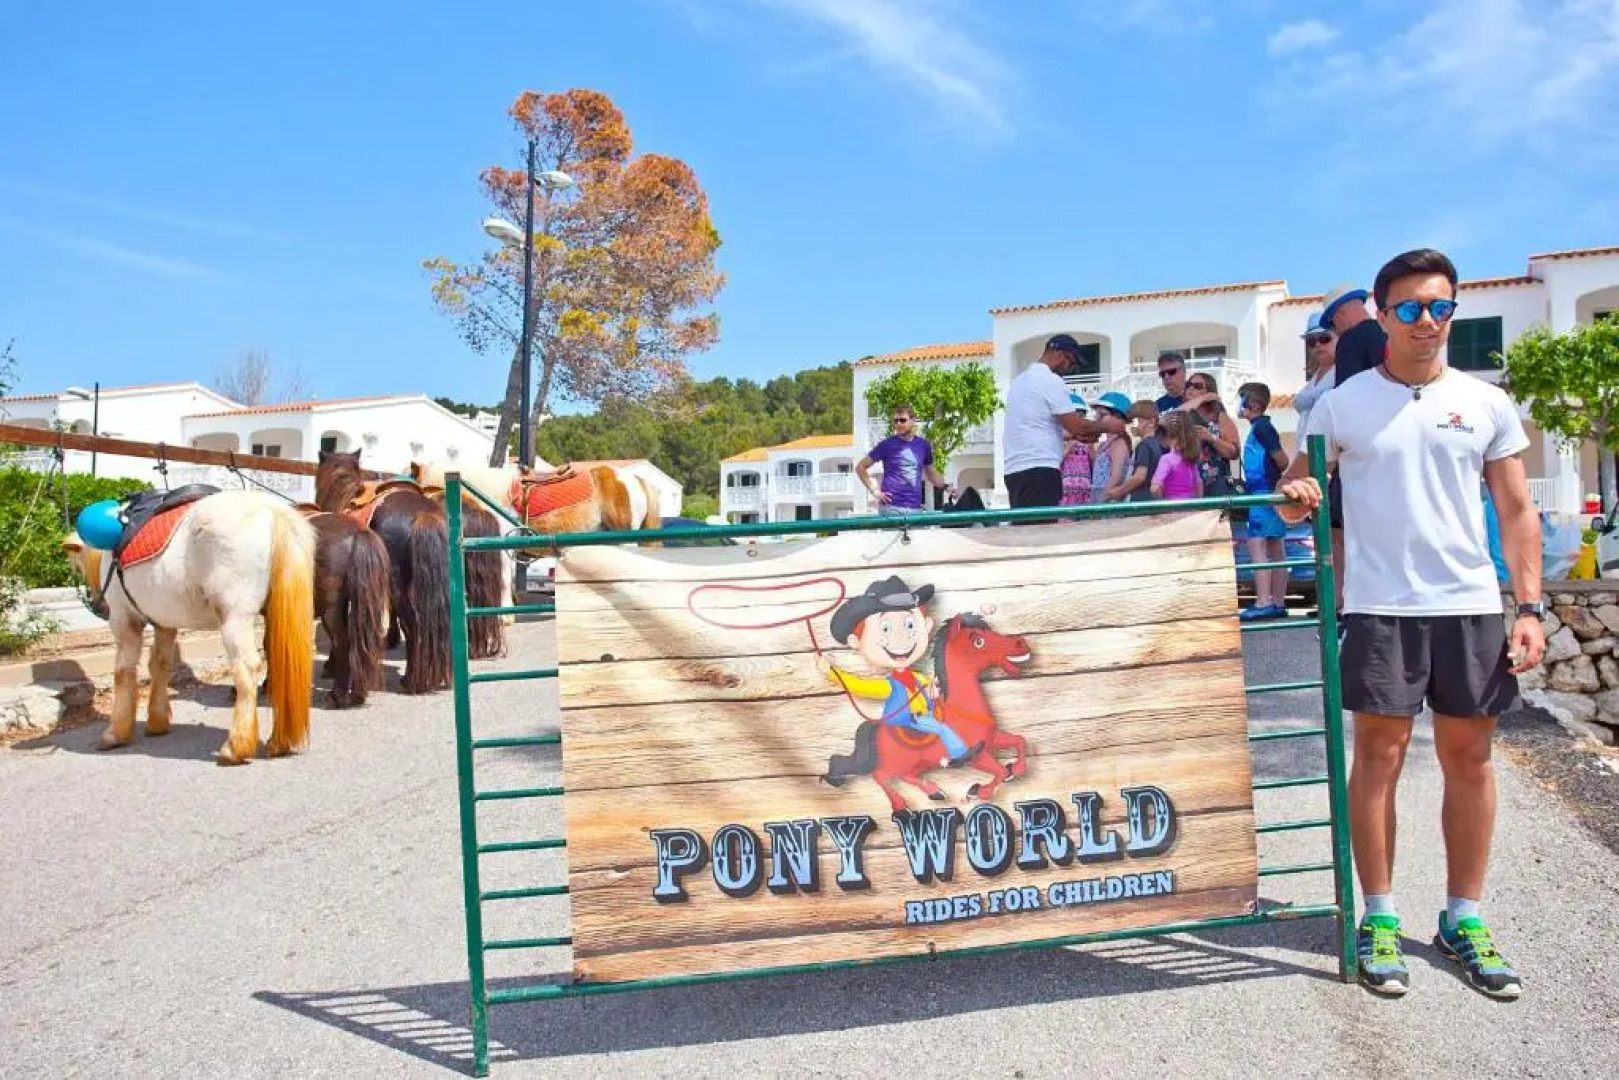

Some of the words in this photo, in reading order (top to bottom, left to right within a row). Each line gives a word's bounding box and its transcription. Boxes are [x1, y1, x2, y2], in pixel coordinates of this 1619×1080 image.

[650, 815, 877, 902] PONY
[892, 785, 1177, 884] WORLD
[905, 893, 982, 925] RIDES
[987, 886, 1040, 914] FOR
[1047, 869, 1176, 907] CHILDREN
